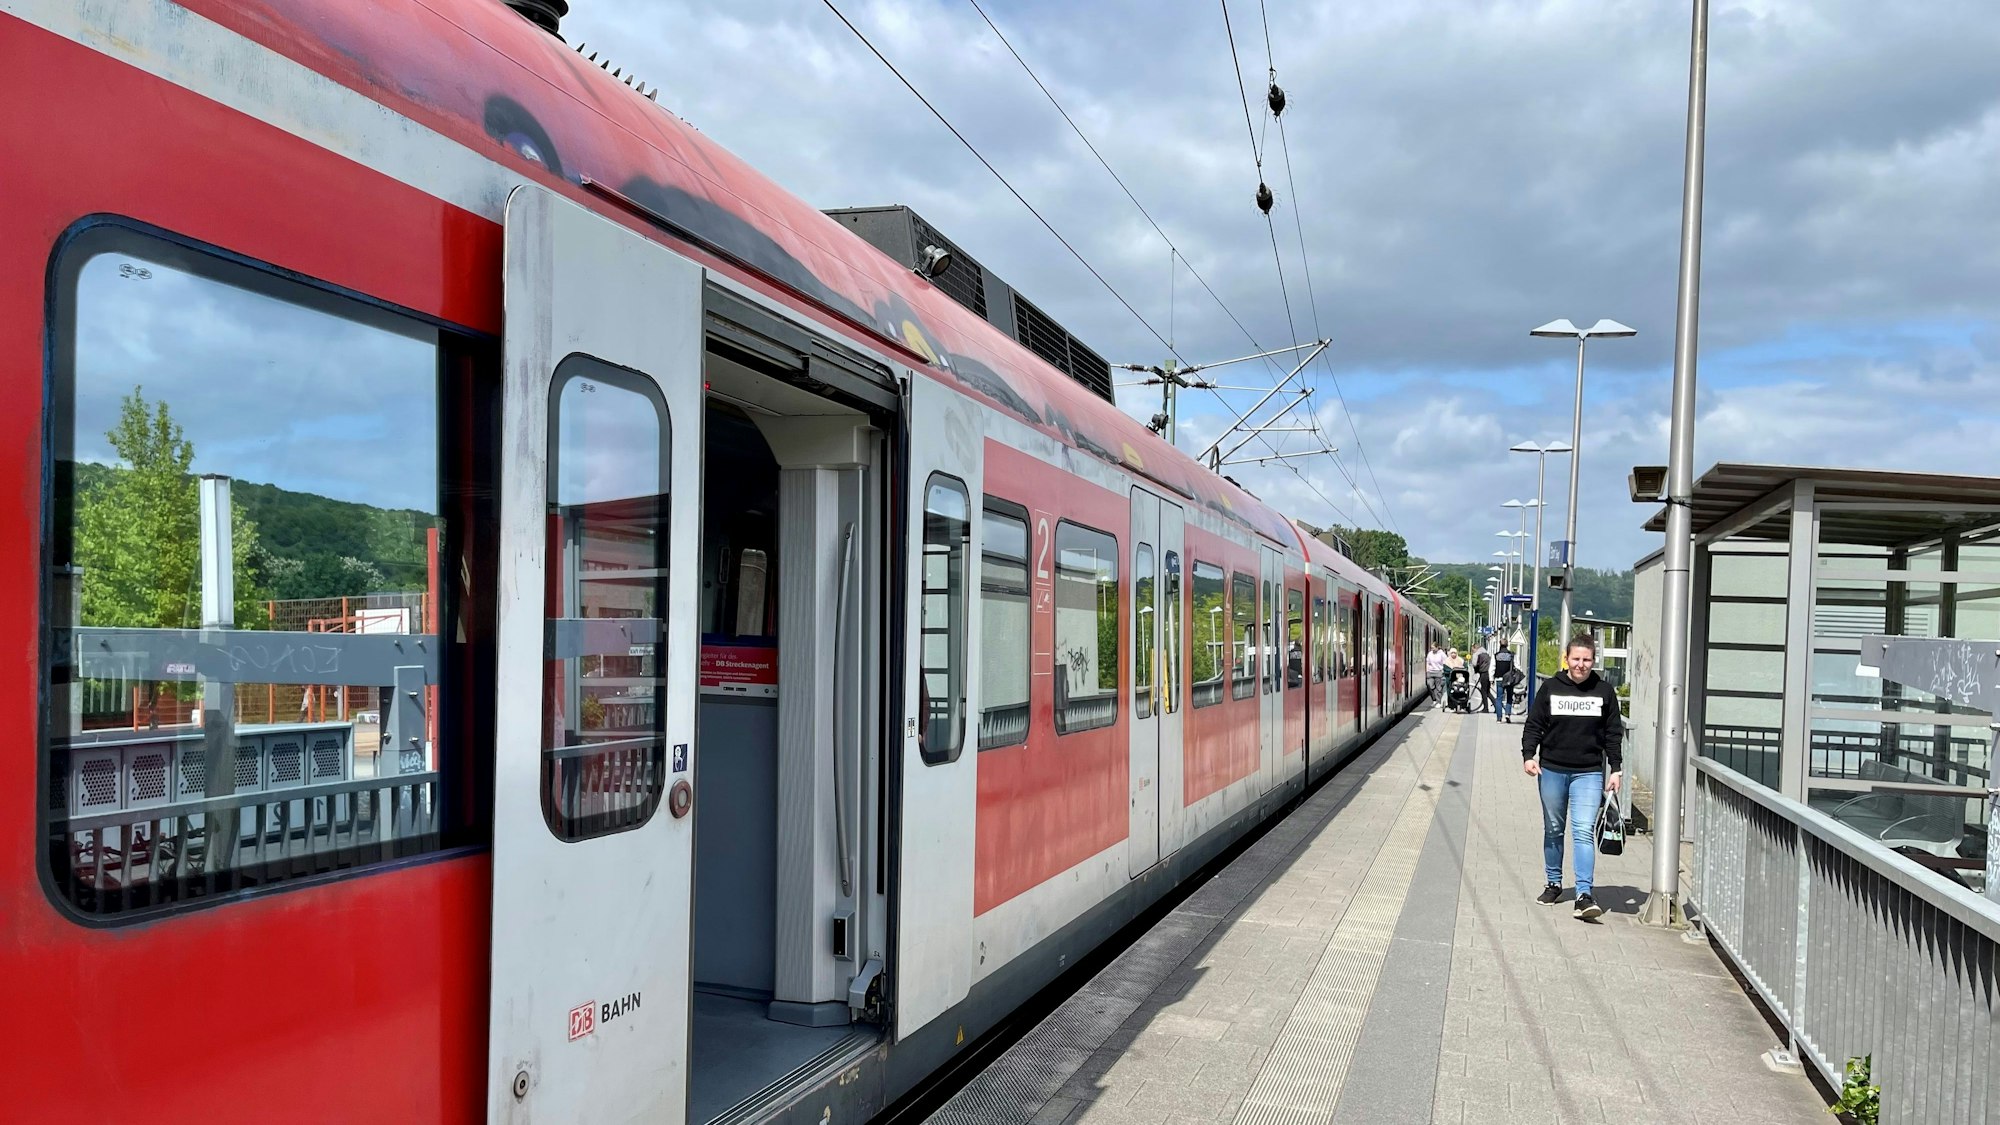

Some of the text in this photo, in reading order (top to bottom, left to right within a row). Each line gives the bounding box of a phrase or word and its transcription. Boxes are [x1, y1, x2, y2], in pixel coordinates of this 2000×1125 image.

[1037, 517, 1049, 579] 2
[725, 661, 769, 669] Streckenagent
[570, 992, 640, 1037] DB BAHN
